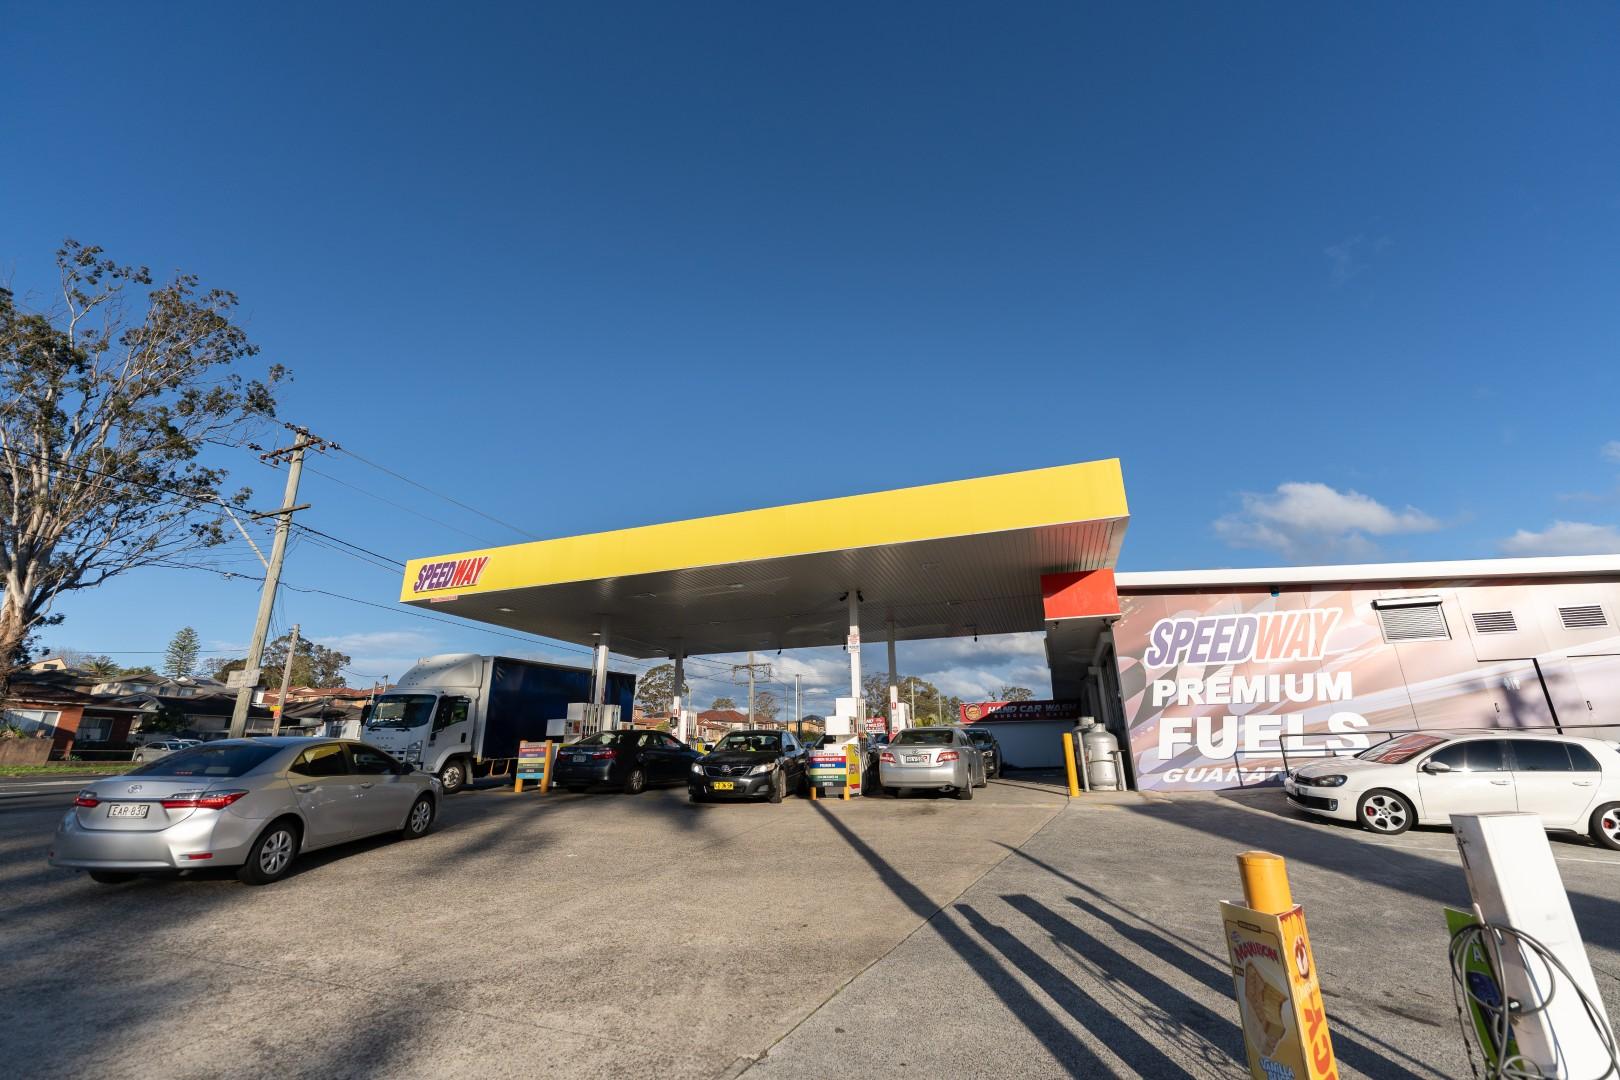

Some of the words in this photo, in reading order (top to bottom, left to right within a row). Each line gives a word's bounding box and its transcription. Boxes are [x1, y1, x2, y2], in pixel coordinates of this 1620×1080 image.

[413, 556, 488, 592] SPEEDWAY
[1146, 608, 1342, 668] SPEEDWAY
[1152, 671, 1354, 707] PREMIUM
[988, 706, 1017, 714] HAND
[1019, 704, 1042, 713] CAR
[1158, 711, 1370, 760] FUELS
